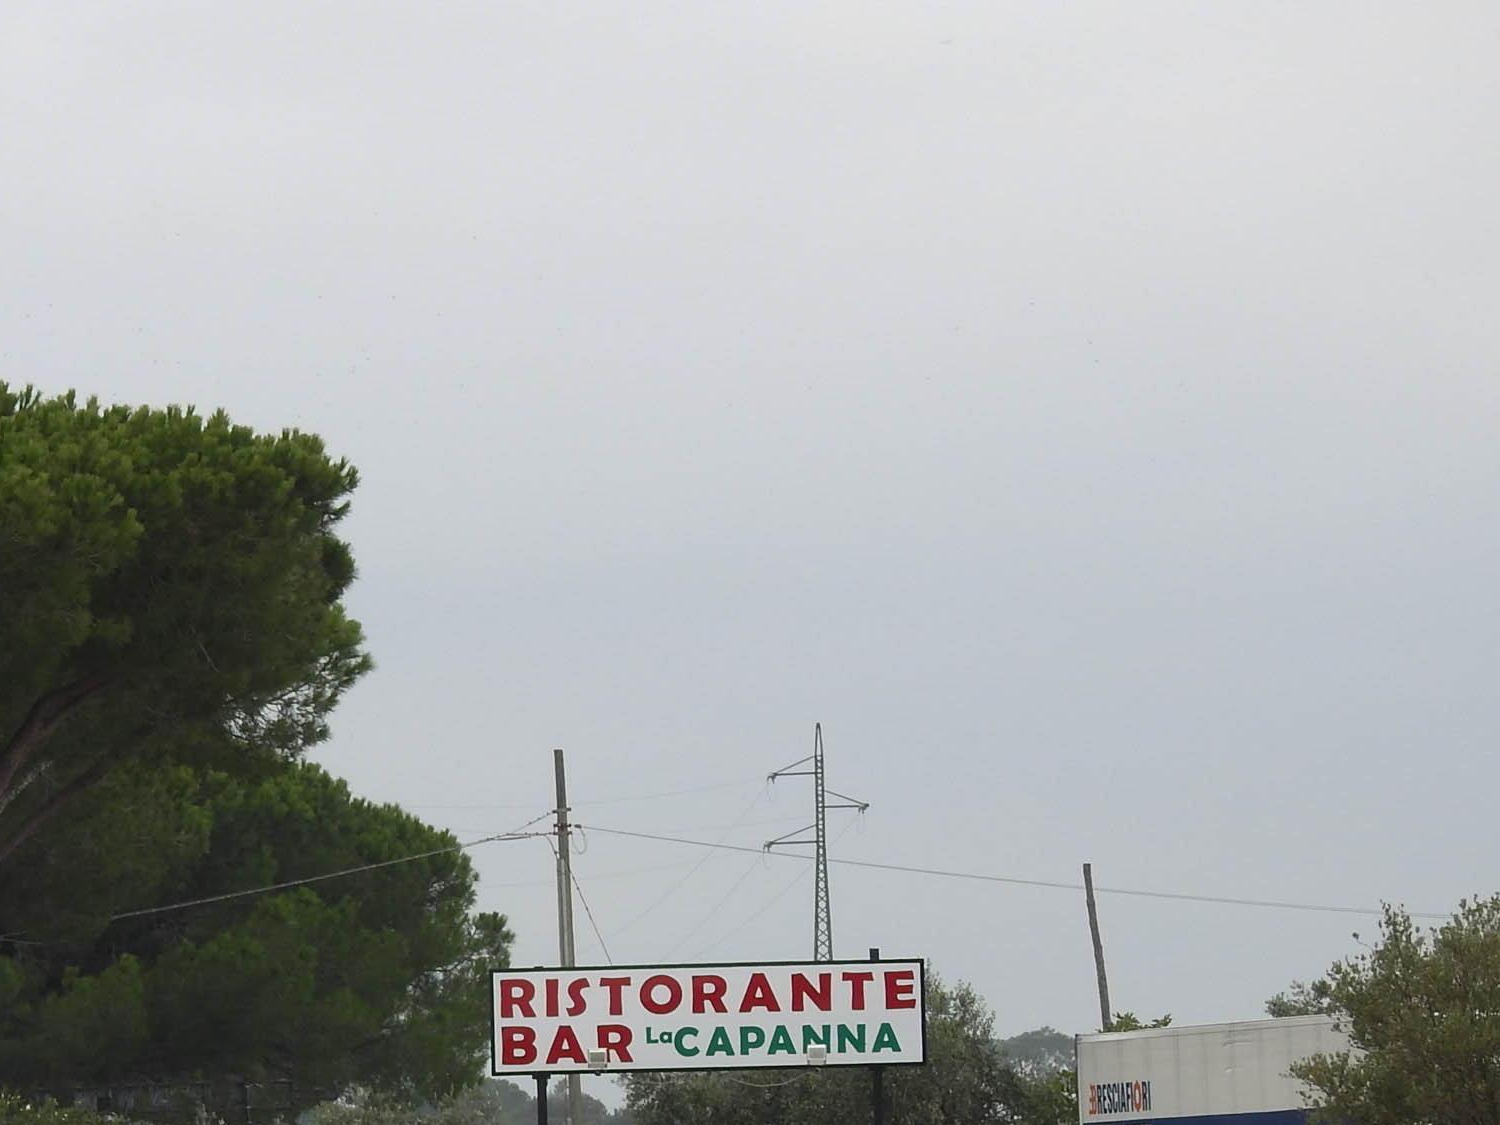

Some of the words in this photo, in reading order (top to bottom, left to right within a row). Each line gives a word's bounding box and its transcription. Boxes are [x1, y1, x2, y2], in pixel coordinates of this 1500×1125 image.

[500, 970, 916, 1018] RISTORANTE
[501, 1025, 633, 1065] BAR
[646, 1027, 673, 1044] La
[674, 1023, 901, 1057] CAPANNA
